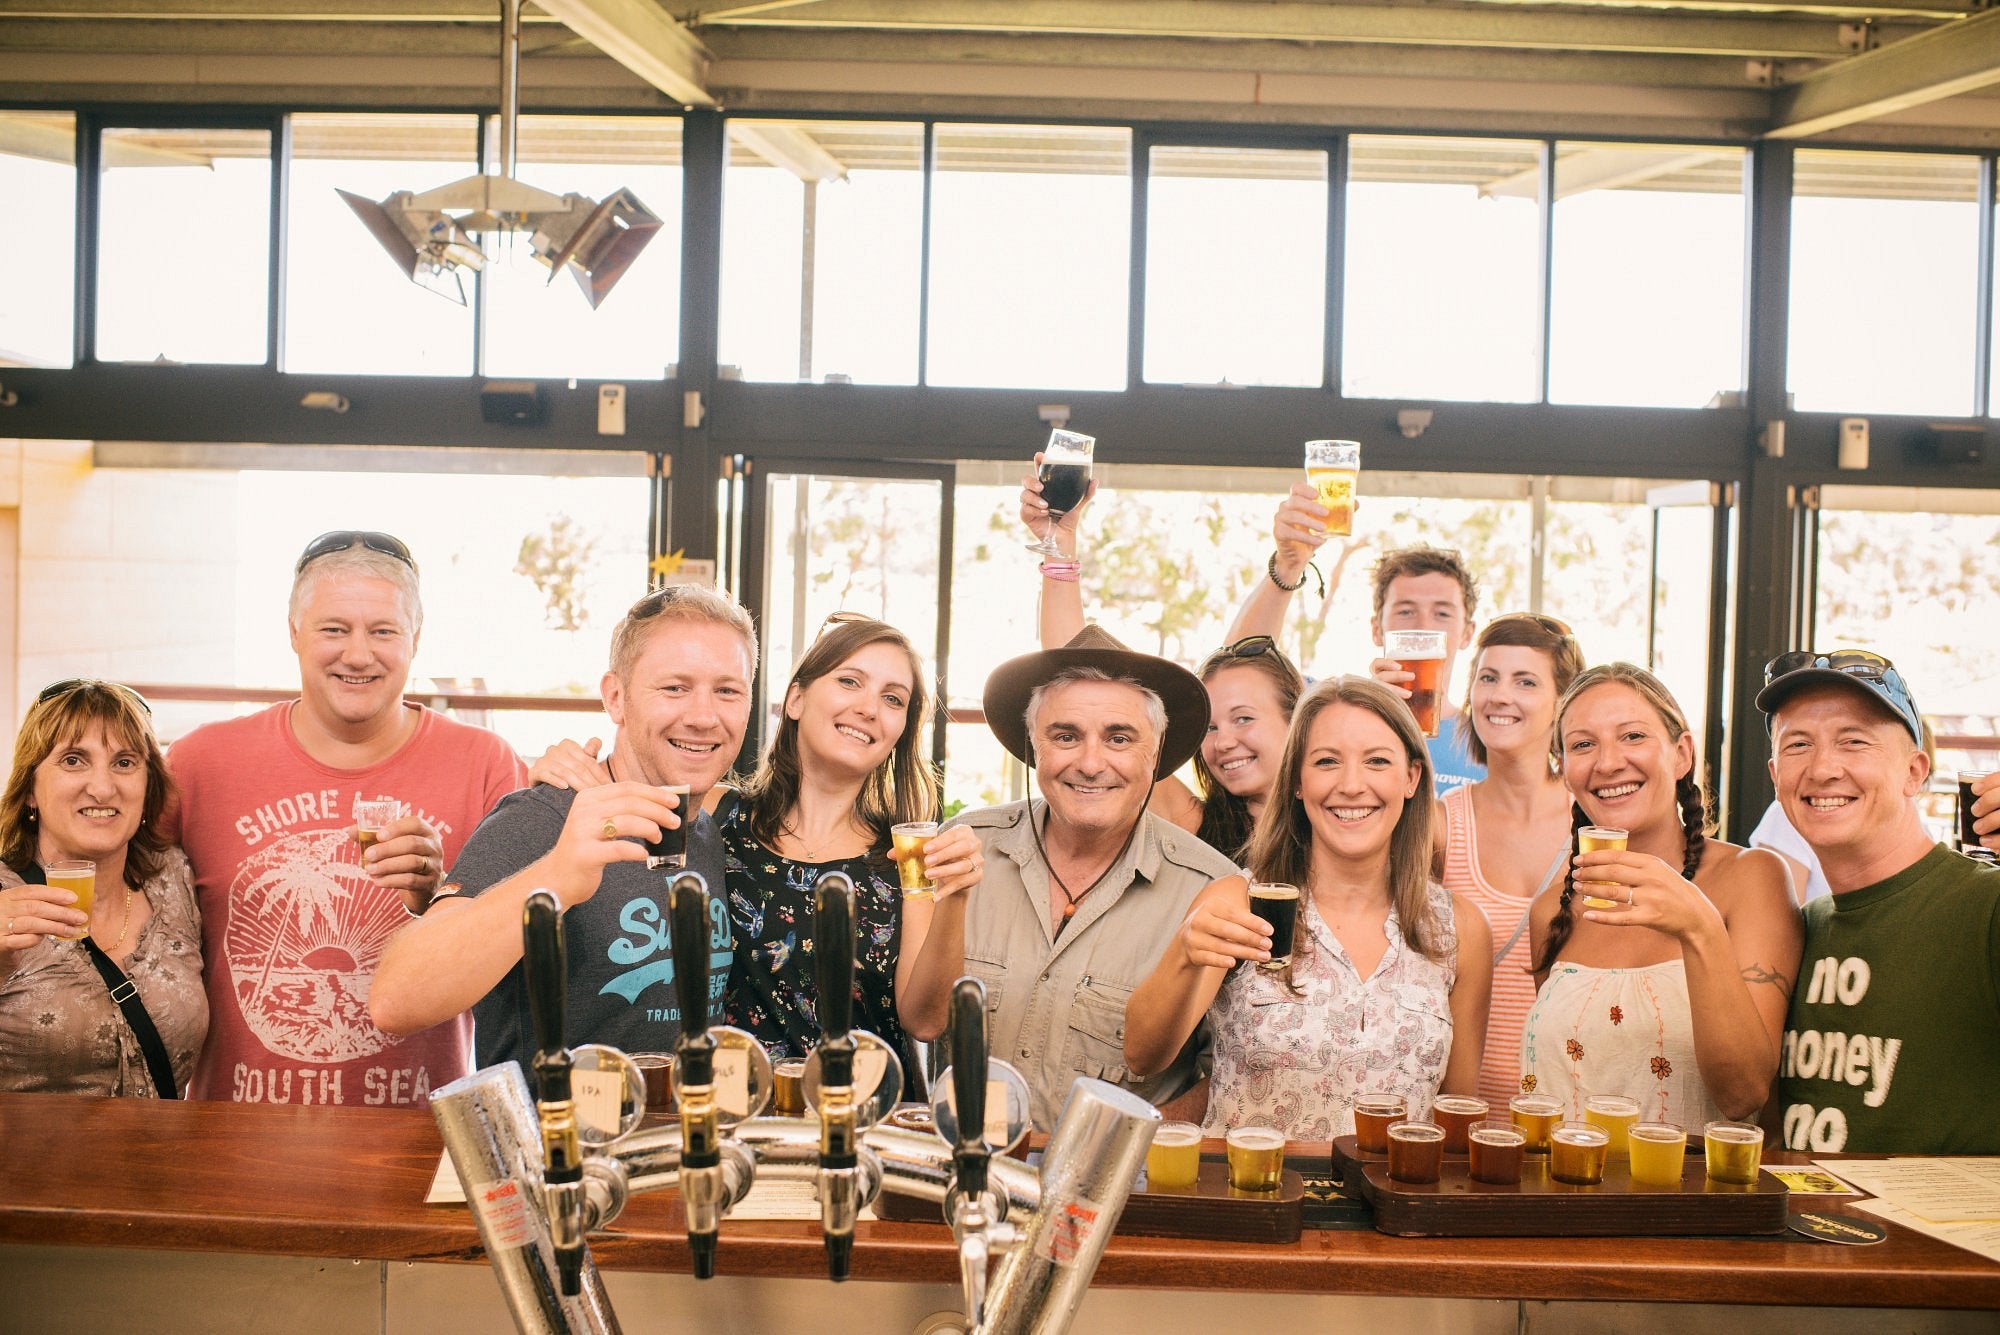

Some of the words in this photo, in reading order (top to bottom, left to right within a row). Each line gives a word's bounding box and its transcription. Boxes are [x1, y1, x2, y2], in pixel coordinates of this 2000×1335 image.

[235, 789, 339, 846] SHORE
[1806, 956, 1871, 1006] no
[233, 1062, 344, 1105] SOUTH
[582, 1085, 601, 1097] IPA
[1784, 1104, 1849, 1153] no
